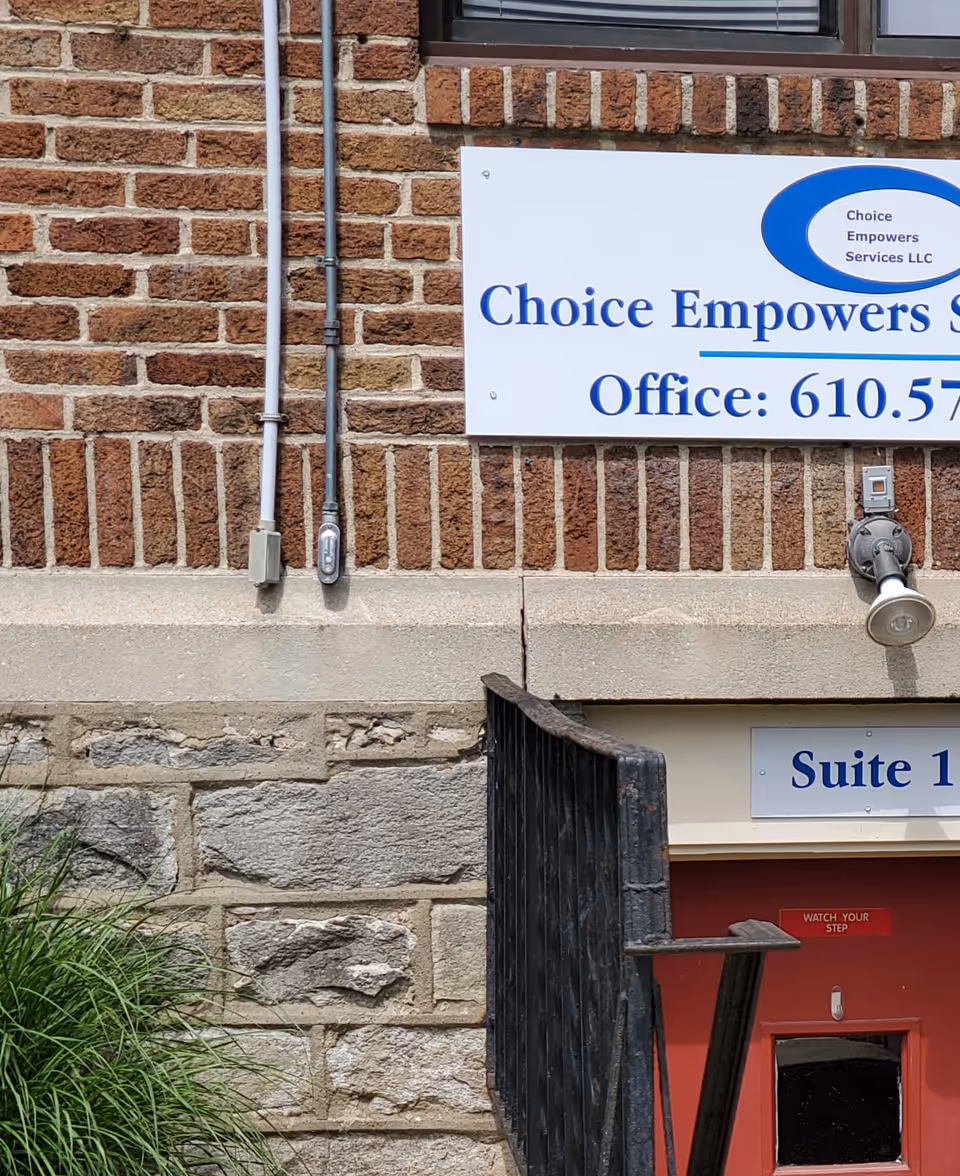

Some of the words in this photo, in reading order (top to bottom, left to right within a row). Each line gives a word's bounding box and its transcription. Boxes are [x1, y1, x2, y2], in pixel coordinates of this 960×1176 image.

[846, 209, 893, 222] Choice
[847, 230, 920, 244] Empowers
[845, 251, 904, 263] Services
[908, 252, 933, 264] LLC
[479, 282, 654, 328] Choice
[671, 288, 931, 343] Empowers
[589, 371, 768, 418] Office:
[791, 749, 912, 789] Suite
[931, 748, 954, 787] 1
[803, 912, 837, 923] WATCH
[842, 912, 870, 923] YOUR
[825, 923, 848, 933] STEP
